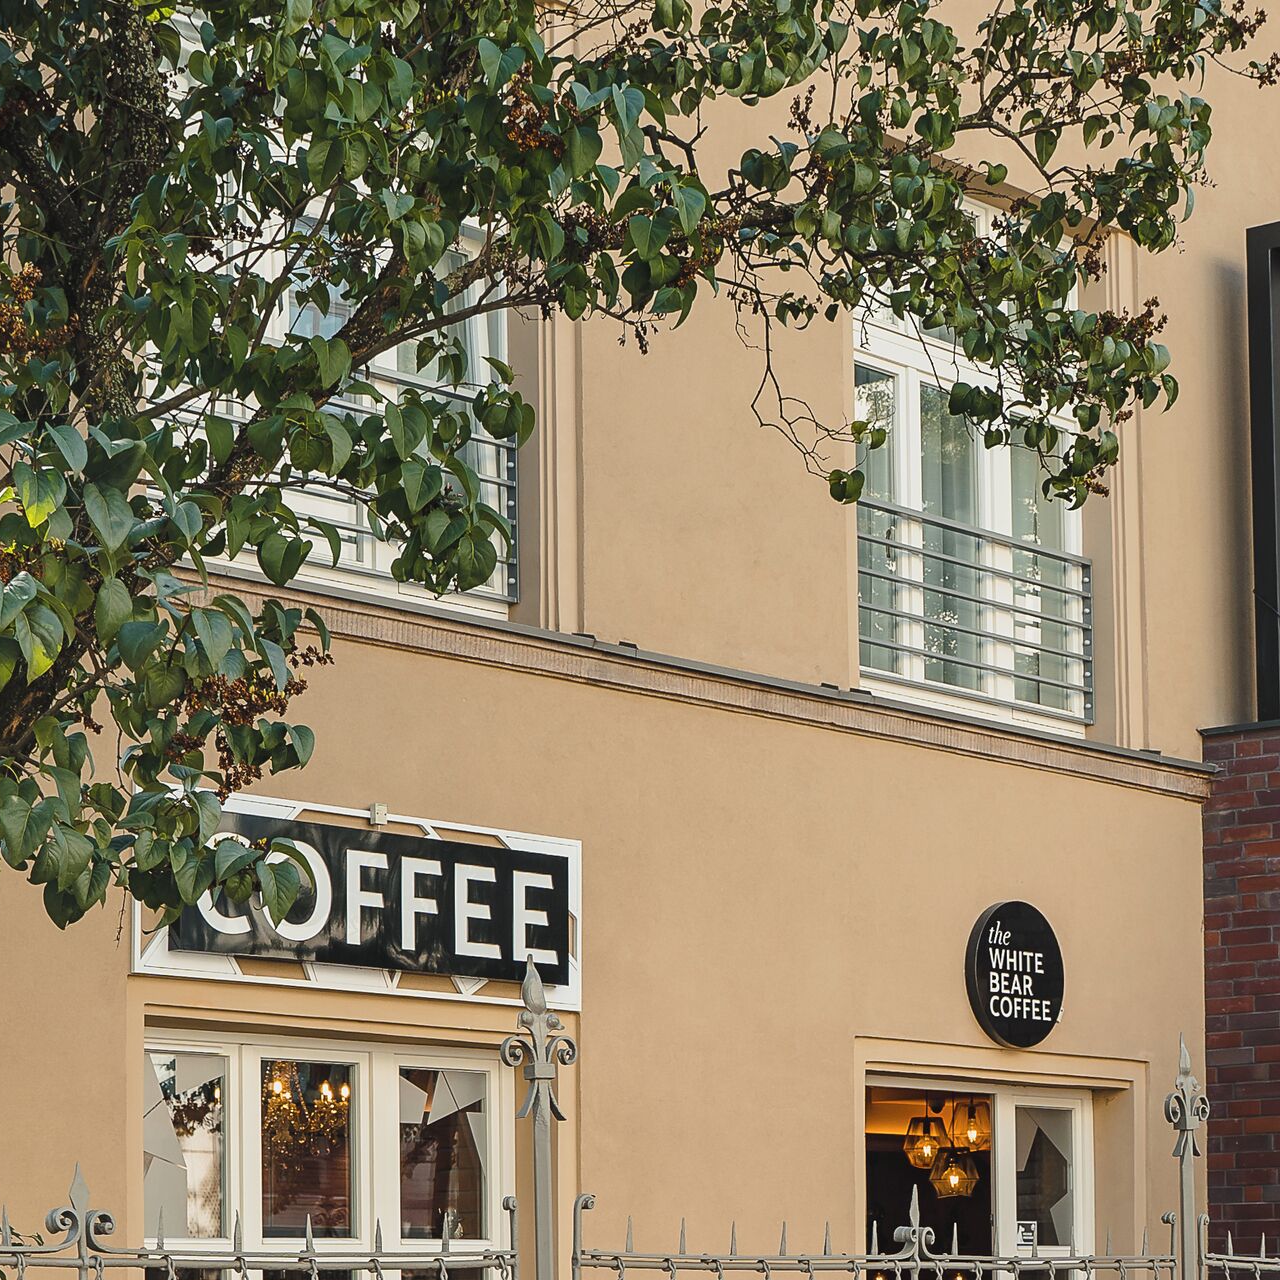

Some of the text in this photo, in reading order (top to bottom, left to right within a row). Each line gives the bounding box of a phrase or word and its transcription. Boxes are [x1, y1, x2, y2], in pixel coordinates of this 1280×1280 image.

[195, 831, 560, 966] COFFEE
[988, 920, 1012, 946] the
[988, 946, 1045, 974] WHITE
[989, 971, 1034, 996] BEAR
[989, 995, 1052, 1021] COFFEE
